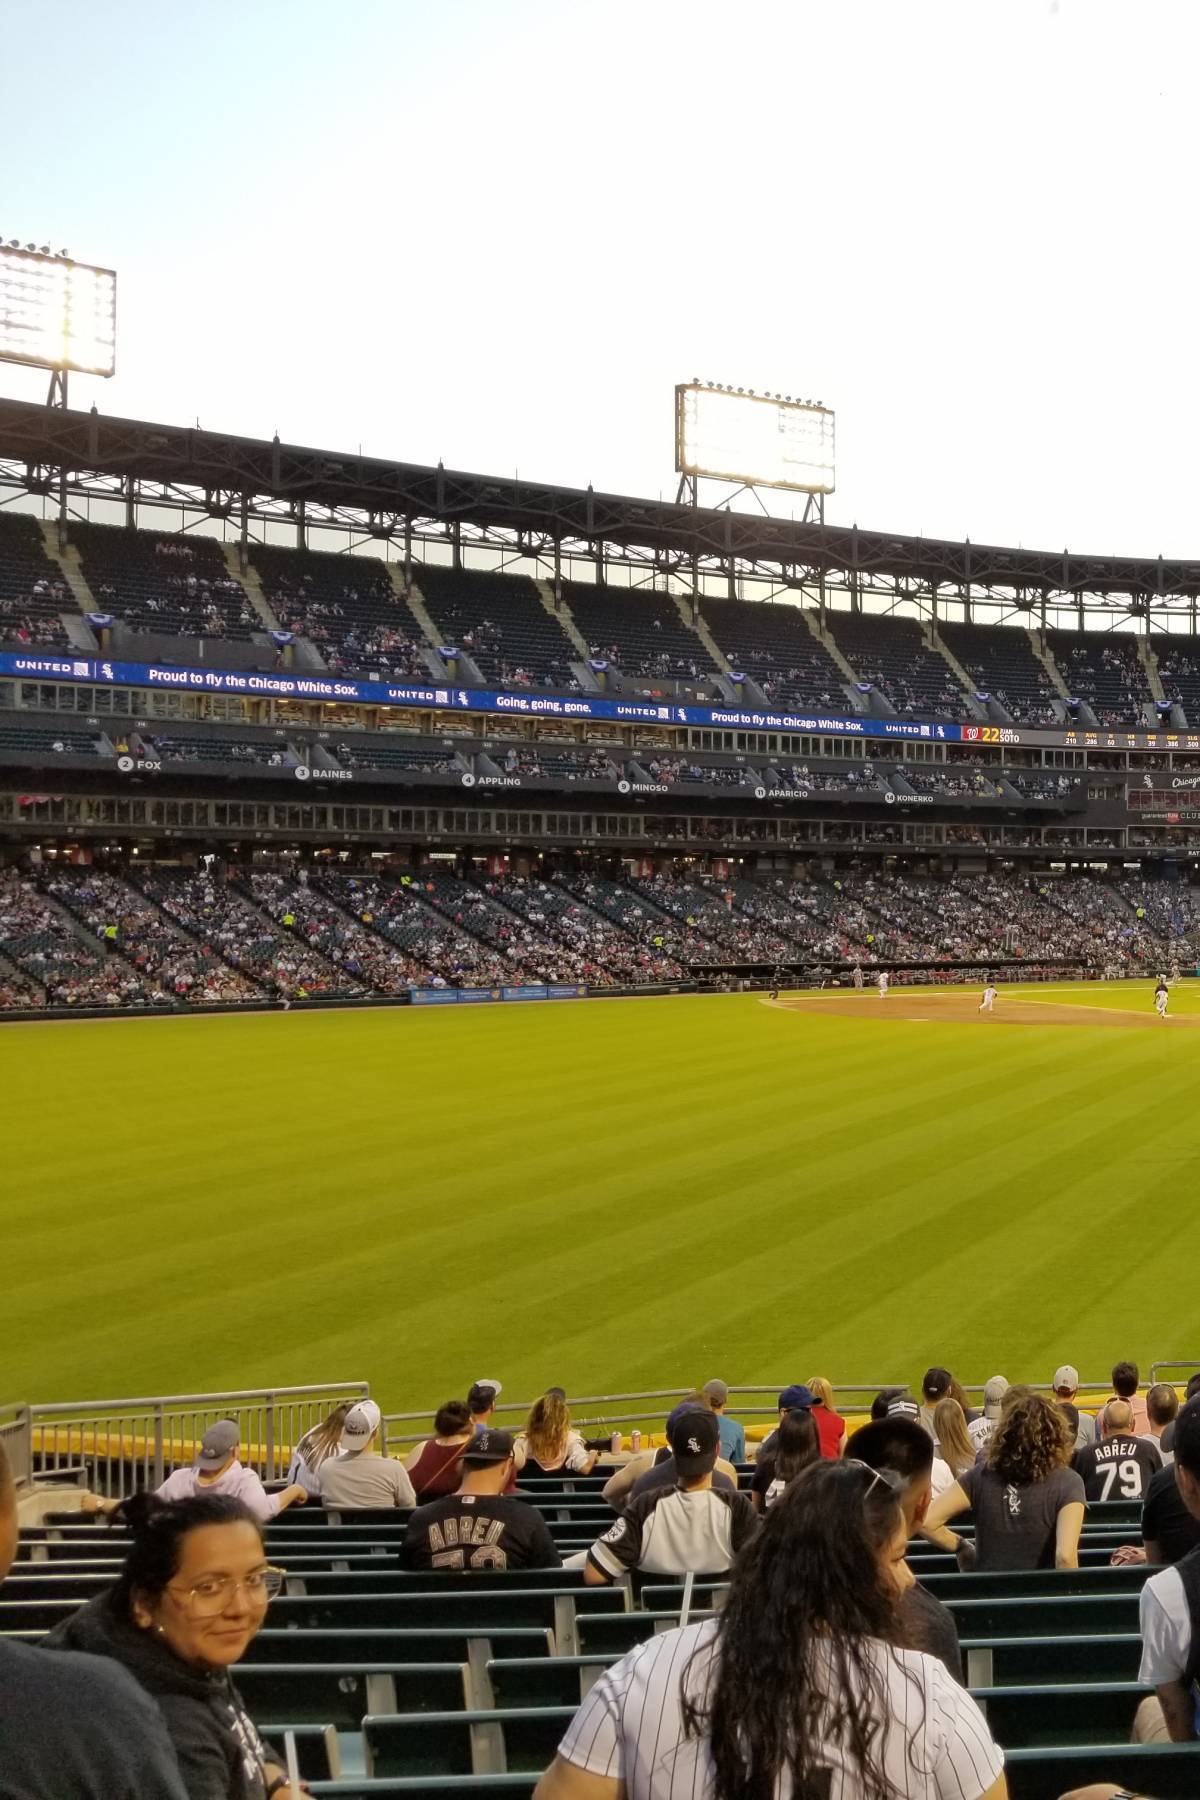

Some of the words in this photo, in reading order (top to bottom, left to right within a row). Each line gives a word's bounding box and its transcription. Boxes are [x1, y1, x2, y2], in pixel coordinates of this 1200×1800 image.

[16, 660, 71, 672] UNITED
[149, 669, 187, 682] Proud
[190, 672, 203, 683] to
[206, 673, 222, 686] fly
[225, 676, 246, 687] the
[249, 678, 294, 691] Chicago
[297, 681, 332, 694] White
[334, 684, 359, 696] Sox.
[388, 689, 434, 700] UNITED
[496, 697, 529, 709] Going,
[531, 700, 562, 712] going,
[564, 703, 592, 713] gone.
[617, 706, 657, 716] UNITED
[711, 713, 739, 723] Proud
[741, 715, 750, 723] to
[753, 715, 765, 726] fly
[767, 716, 781, 725] the
[783, 718, 816, 729] Chicago
[818, 720, 844, 729] White
[846, 722, 864, 731] Sox.
[885, 725, 919, 733] UNITED
[982, 728, 999, 742] 22
[999, 734, 1020, 743] SOTO
[1065, 737, 1077, 745] 210
[137, 760, 162, 770] FOX
[312, 769, 353, 779] BAINES
[478, 776, 521, 786] APPLING
[632, 783, 669, 792] MINOSO
[768, 789, 808, 798] APARICIO
[896, 794, 934, 803] KONERKO
[1095, 1442, 1137, 1461] ABREU
[1095, 1460, 1143, 1501] 79
[428, 1516, 505, 1552] ABREU
